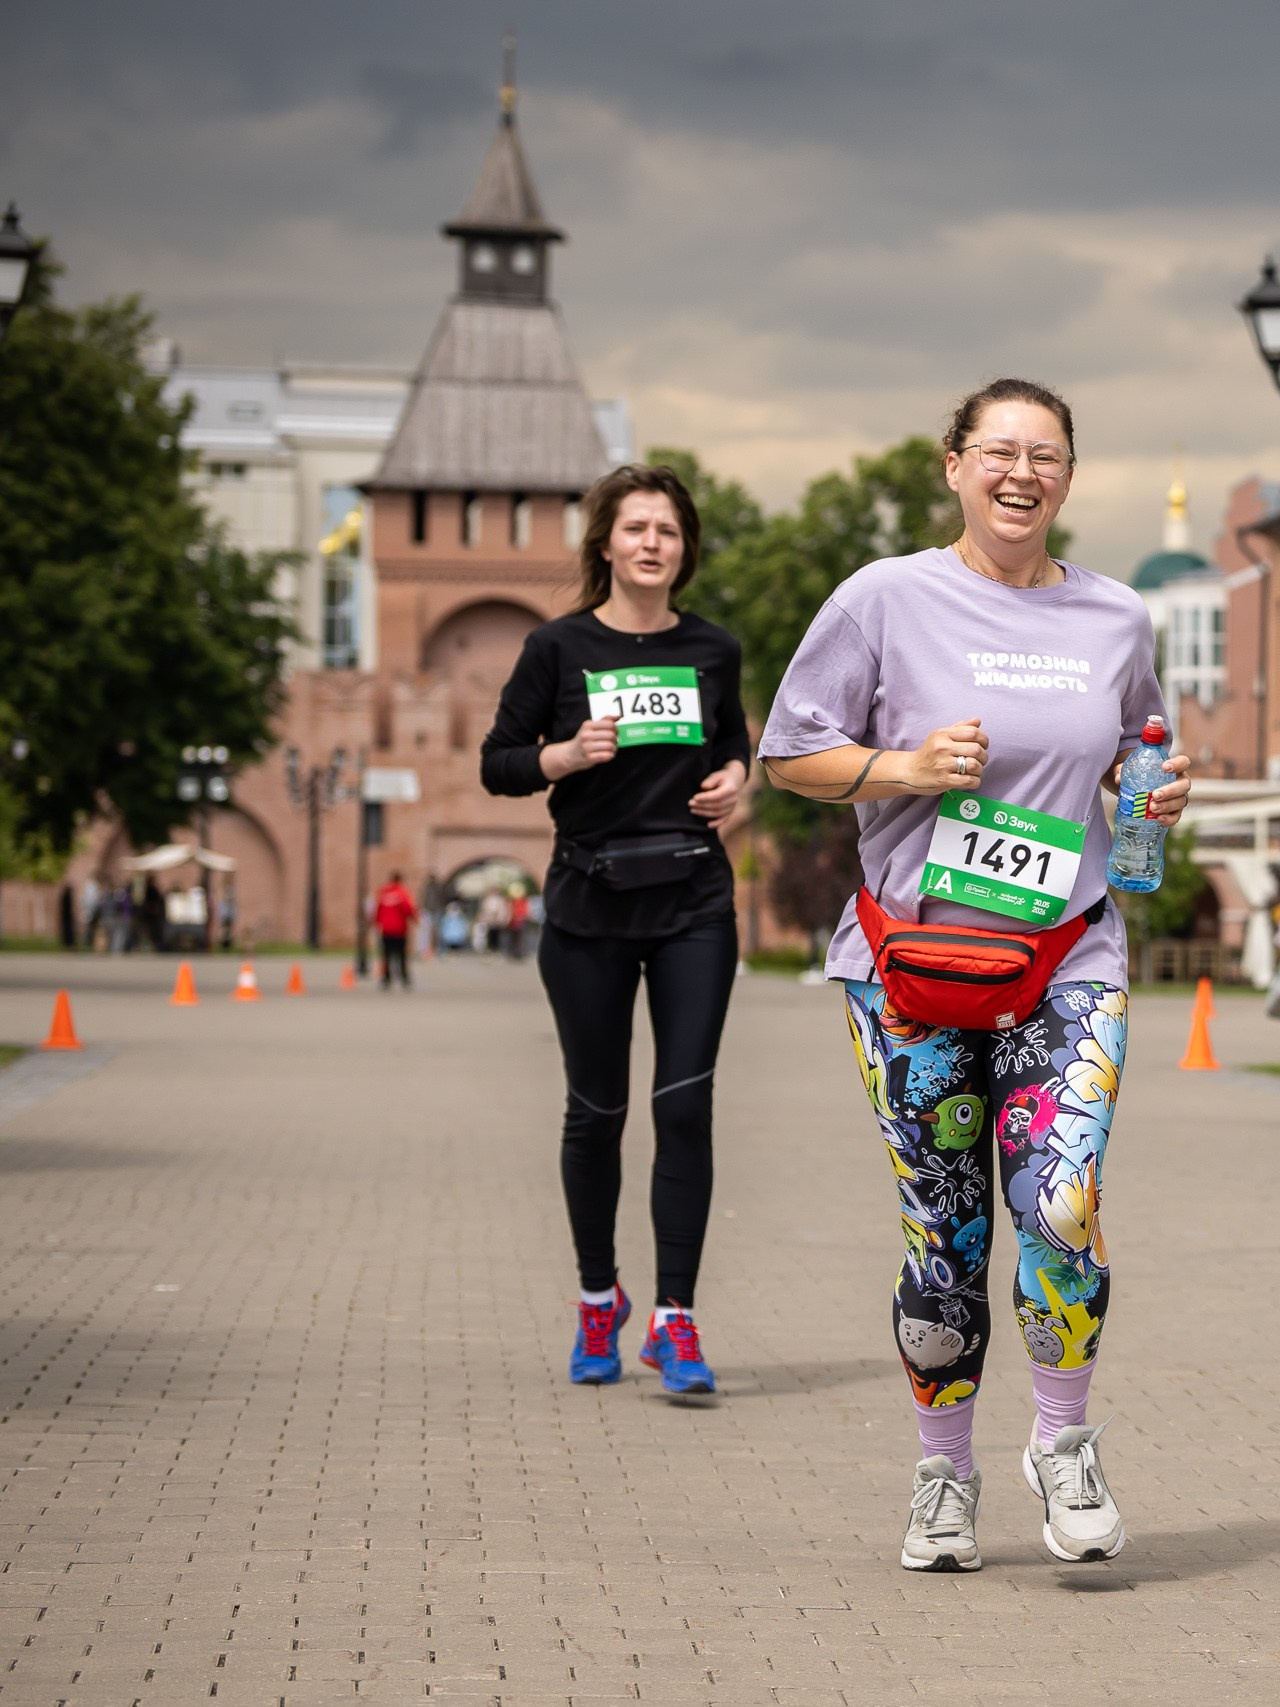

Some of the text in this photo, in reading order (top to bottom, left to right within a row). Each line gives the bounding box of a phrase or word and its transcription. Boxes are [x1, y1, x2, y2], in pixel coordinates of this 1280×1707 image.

[966, 652, 1090, 674] ТОРМОЗНАЯ
[973, 671, 1088, 692] ЖИДКОСТЬ
[613, 692, 682, 718] 1483
[963, 802, 977, 813] 4,2
[1008, 816, 1038, 832] Звук
[962, 831, 1052, 885] 1491
[1031, 906, 1046, 916] 2026
[1033, 898, 1051, 909] 30.05
